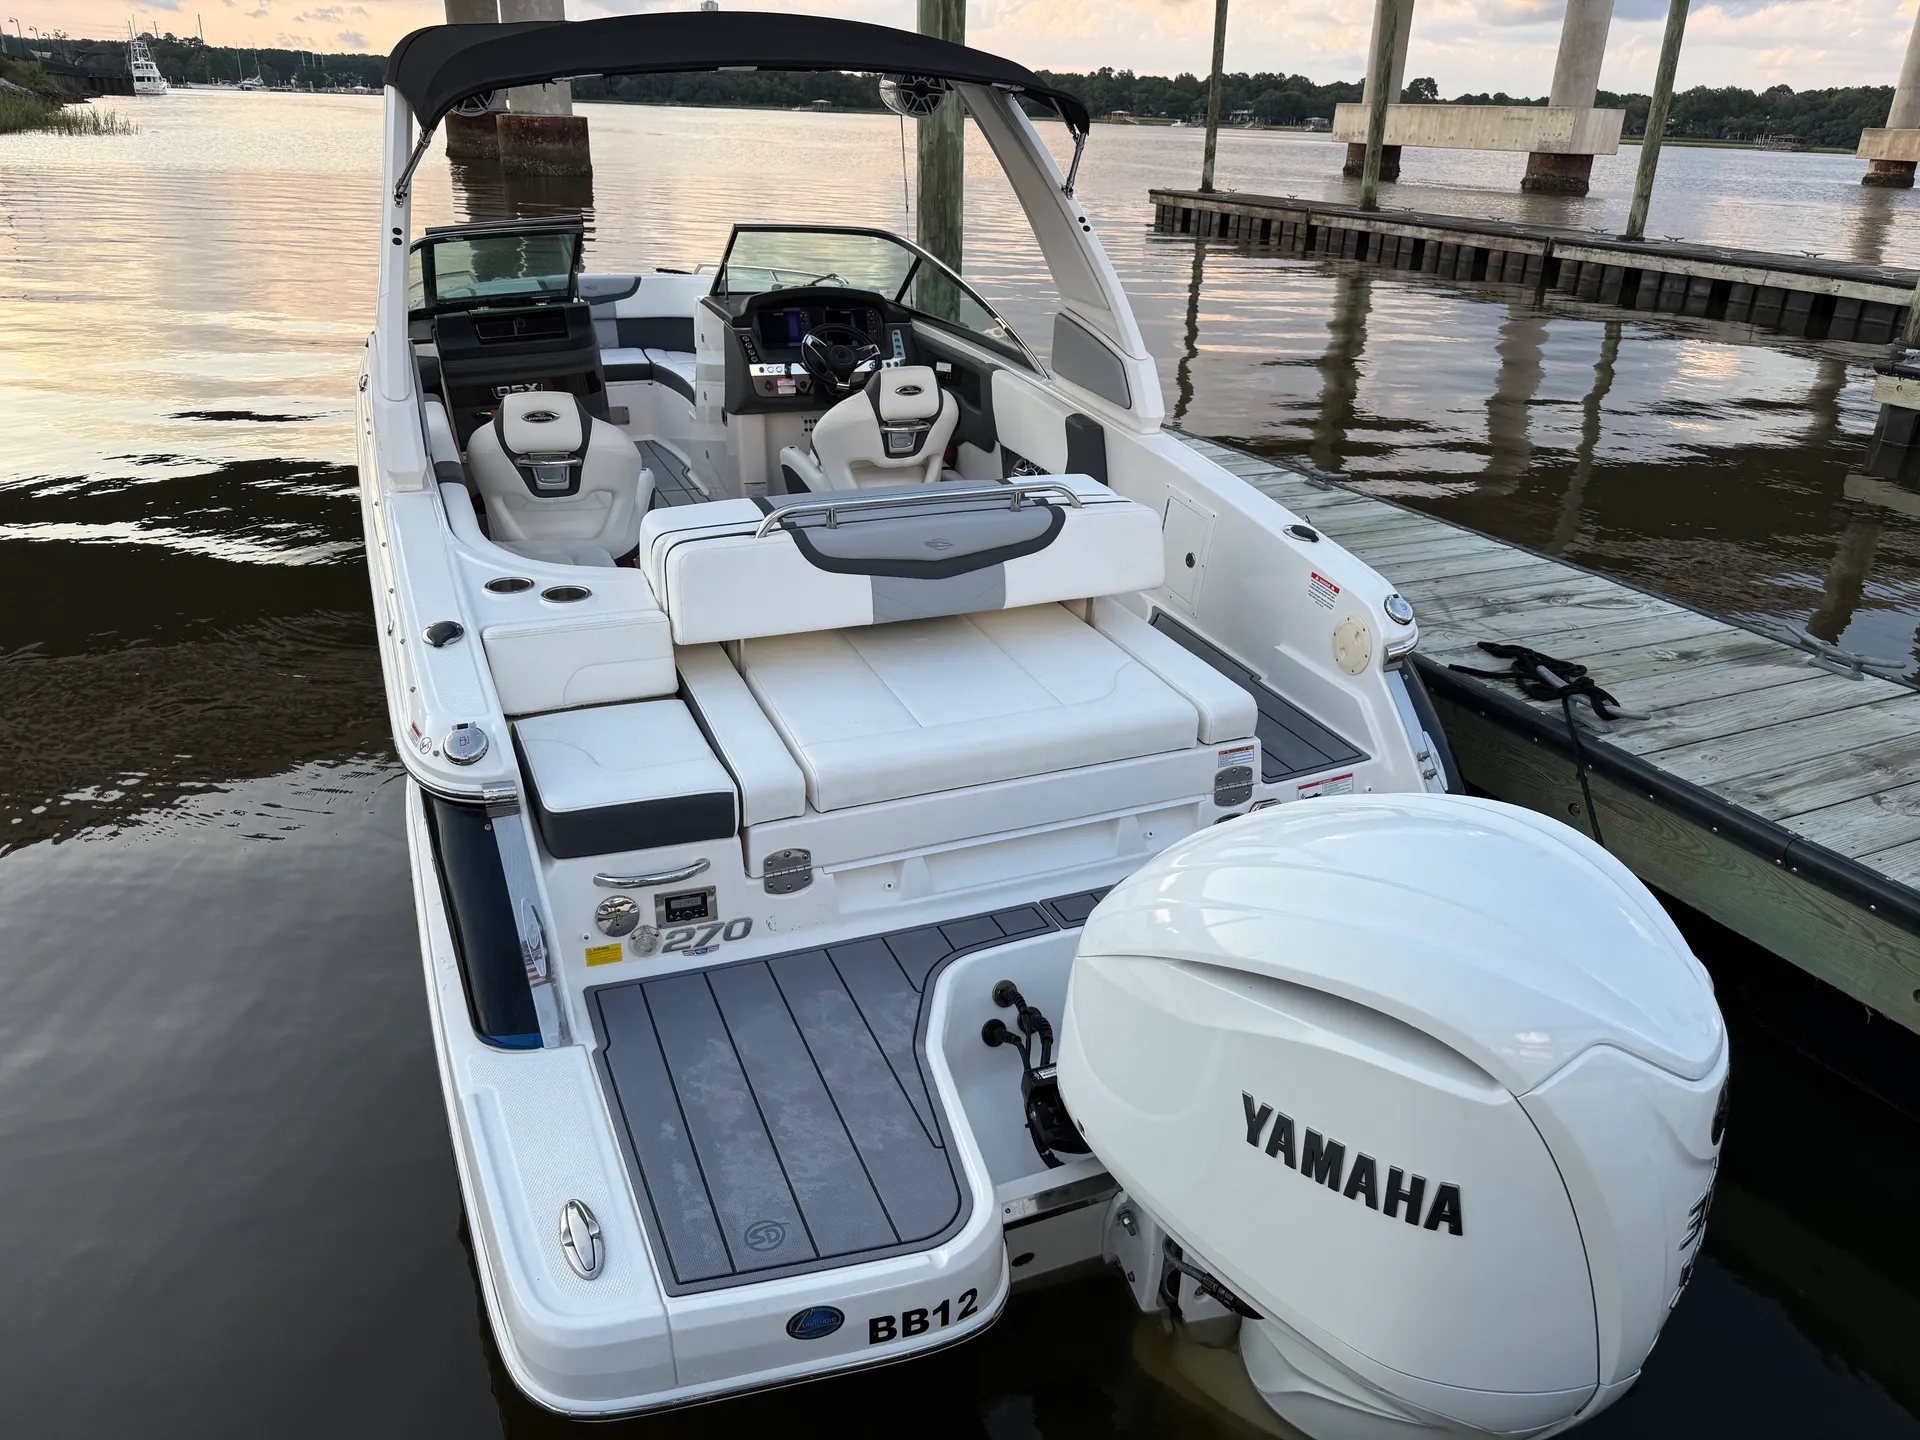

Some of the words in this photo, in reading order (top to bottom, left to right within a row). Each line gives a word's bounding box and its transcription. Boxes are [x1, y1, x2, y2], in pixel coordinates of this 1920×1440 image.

[661, 917, 753, 953] 270
[1242, 1090, 1463, 1236] YAMAHA
[868, 1288, 978, 1345] BB12
